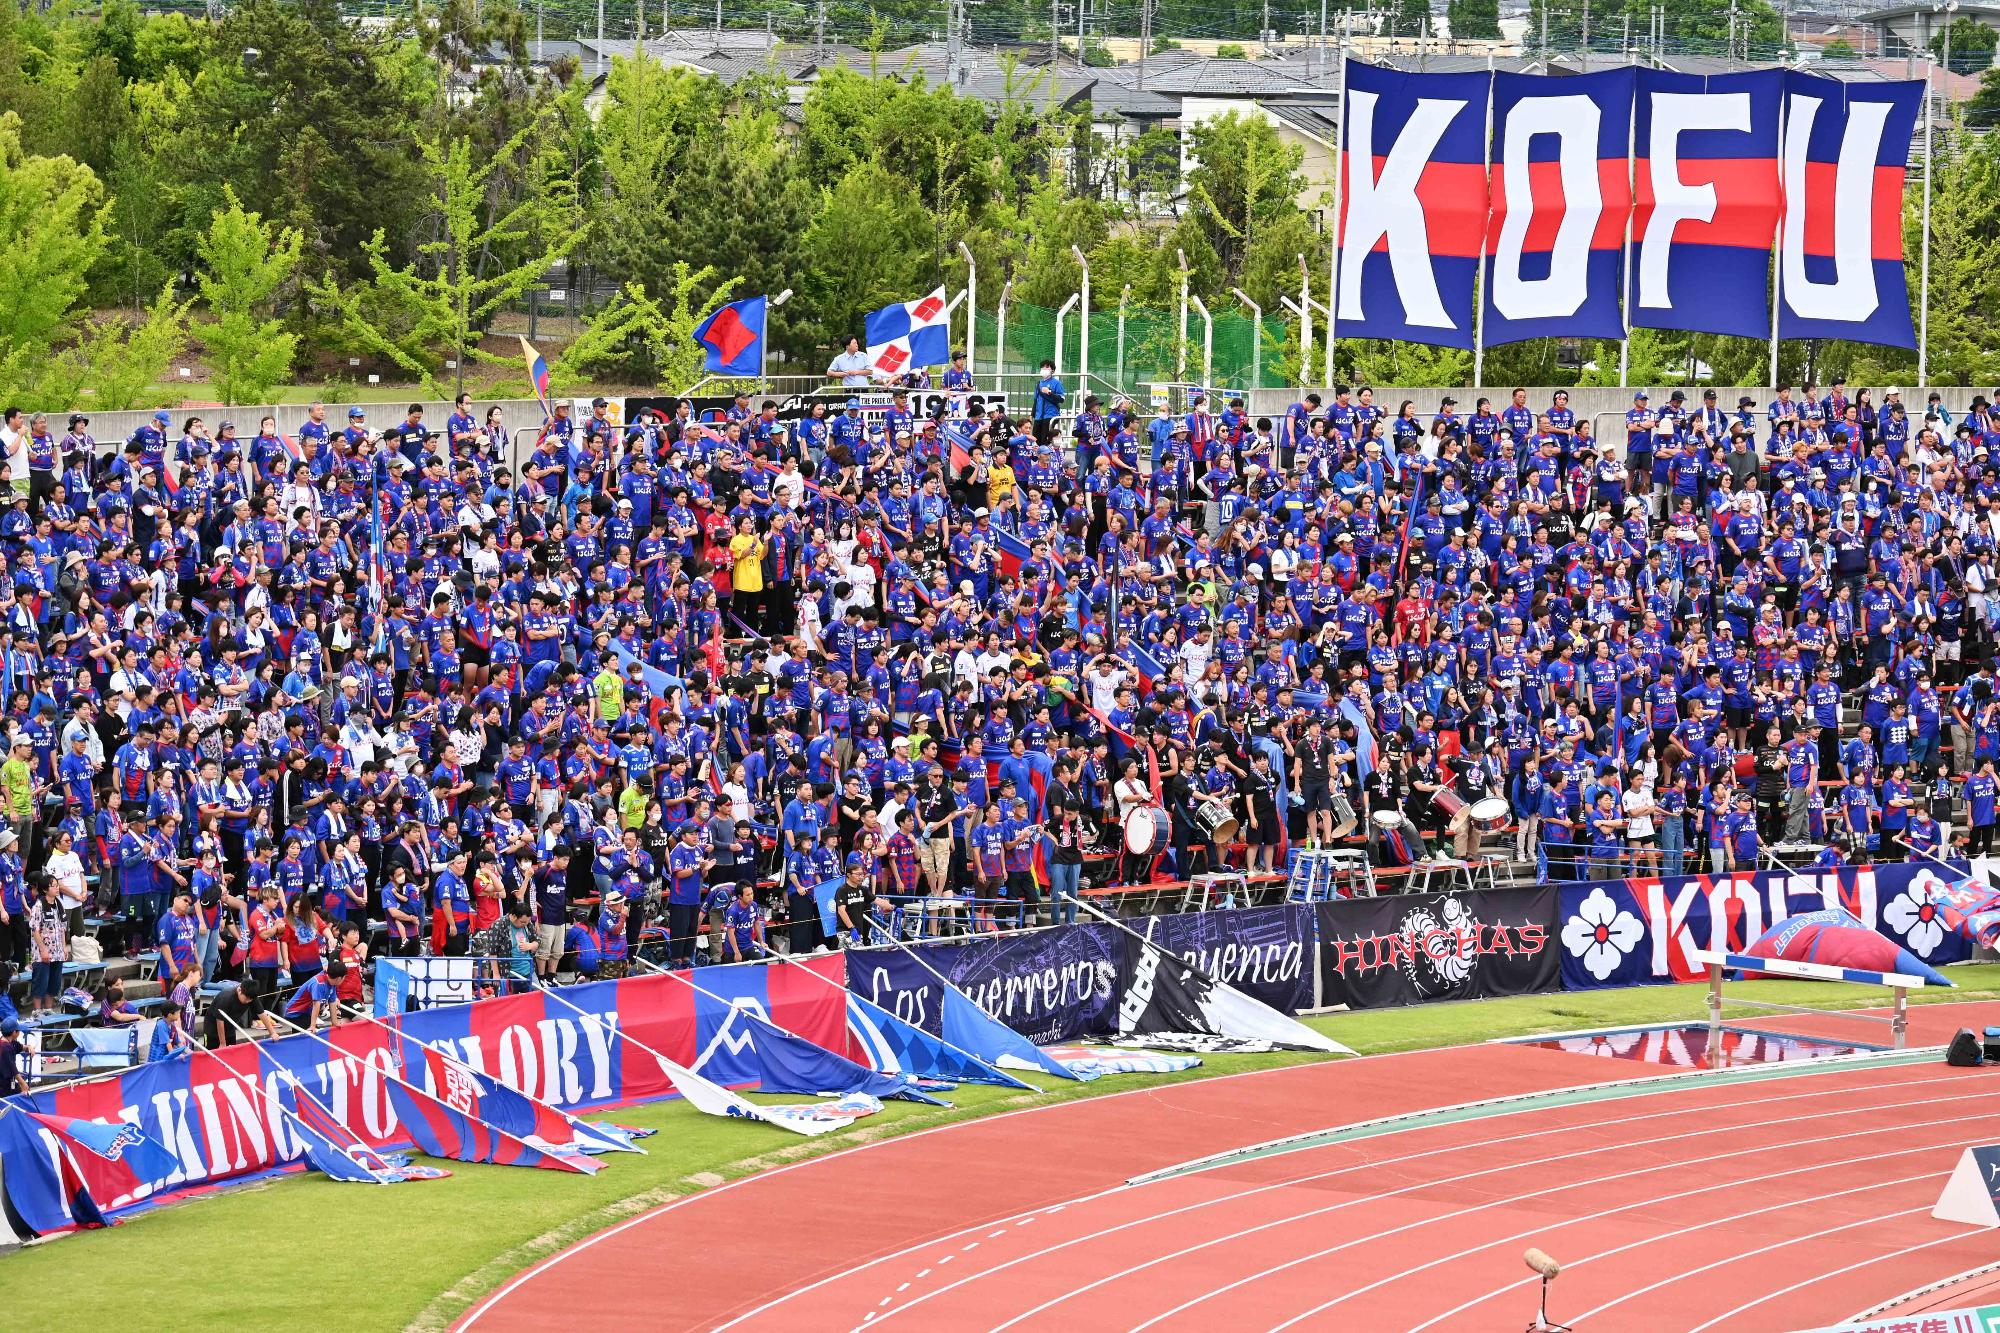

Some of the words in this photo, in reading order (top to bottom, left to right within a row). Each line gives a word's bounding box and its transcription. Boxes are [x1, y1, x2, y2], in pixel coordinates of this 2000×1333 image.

[1337, 89, 1895, 329] KOFU
[1221, 501, 1233, 518] 10
[1331, 918, 1549, 979] HINCHAS
[871, 966, 930, 1027] Los
[975, 961, 1117, 1020] uerreros
[316, 1047, 401, 1139] TO
